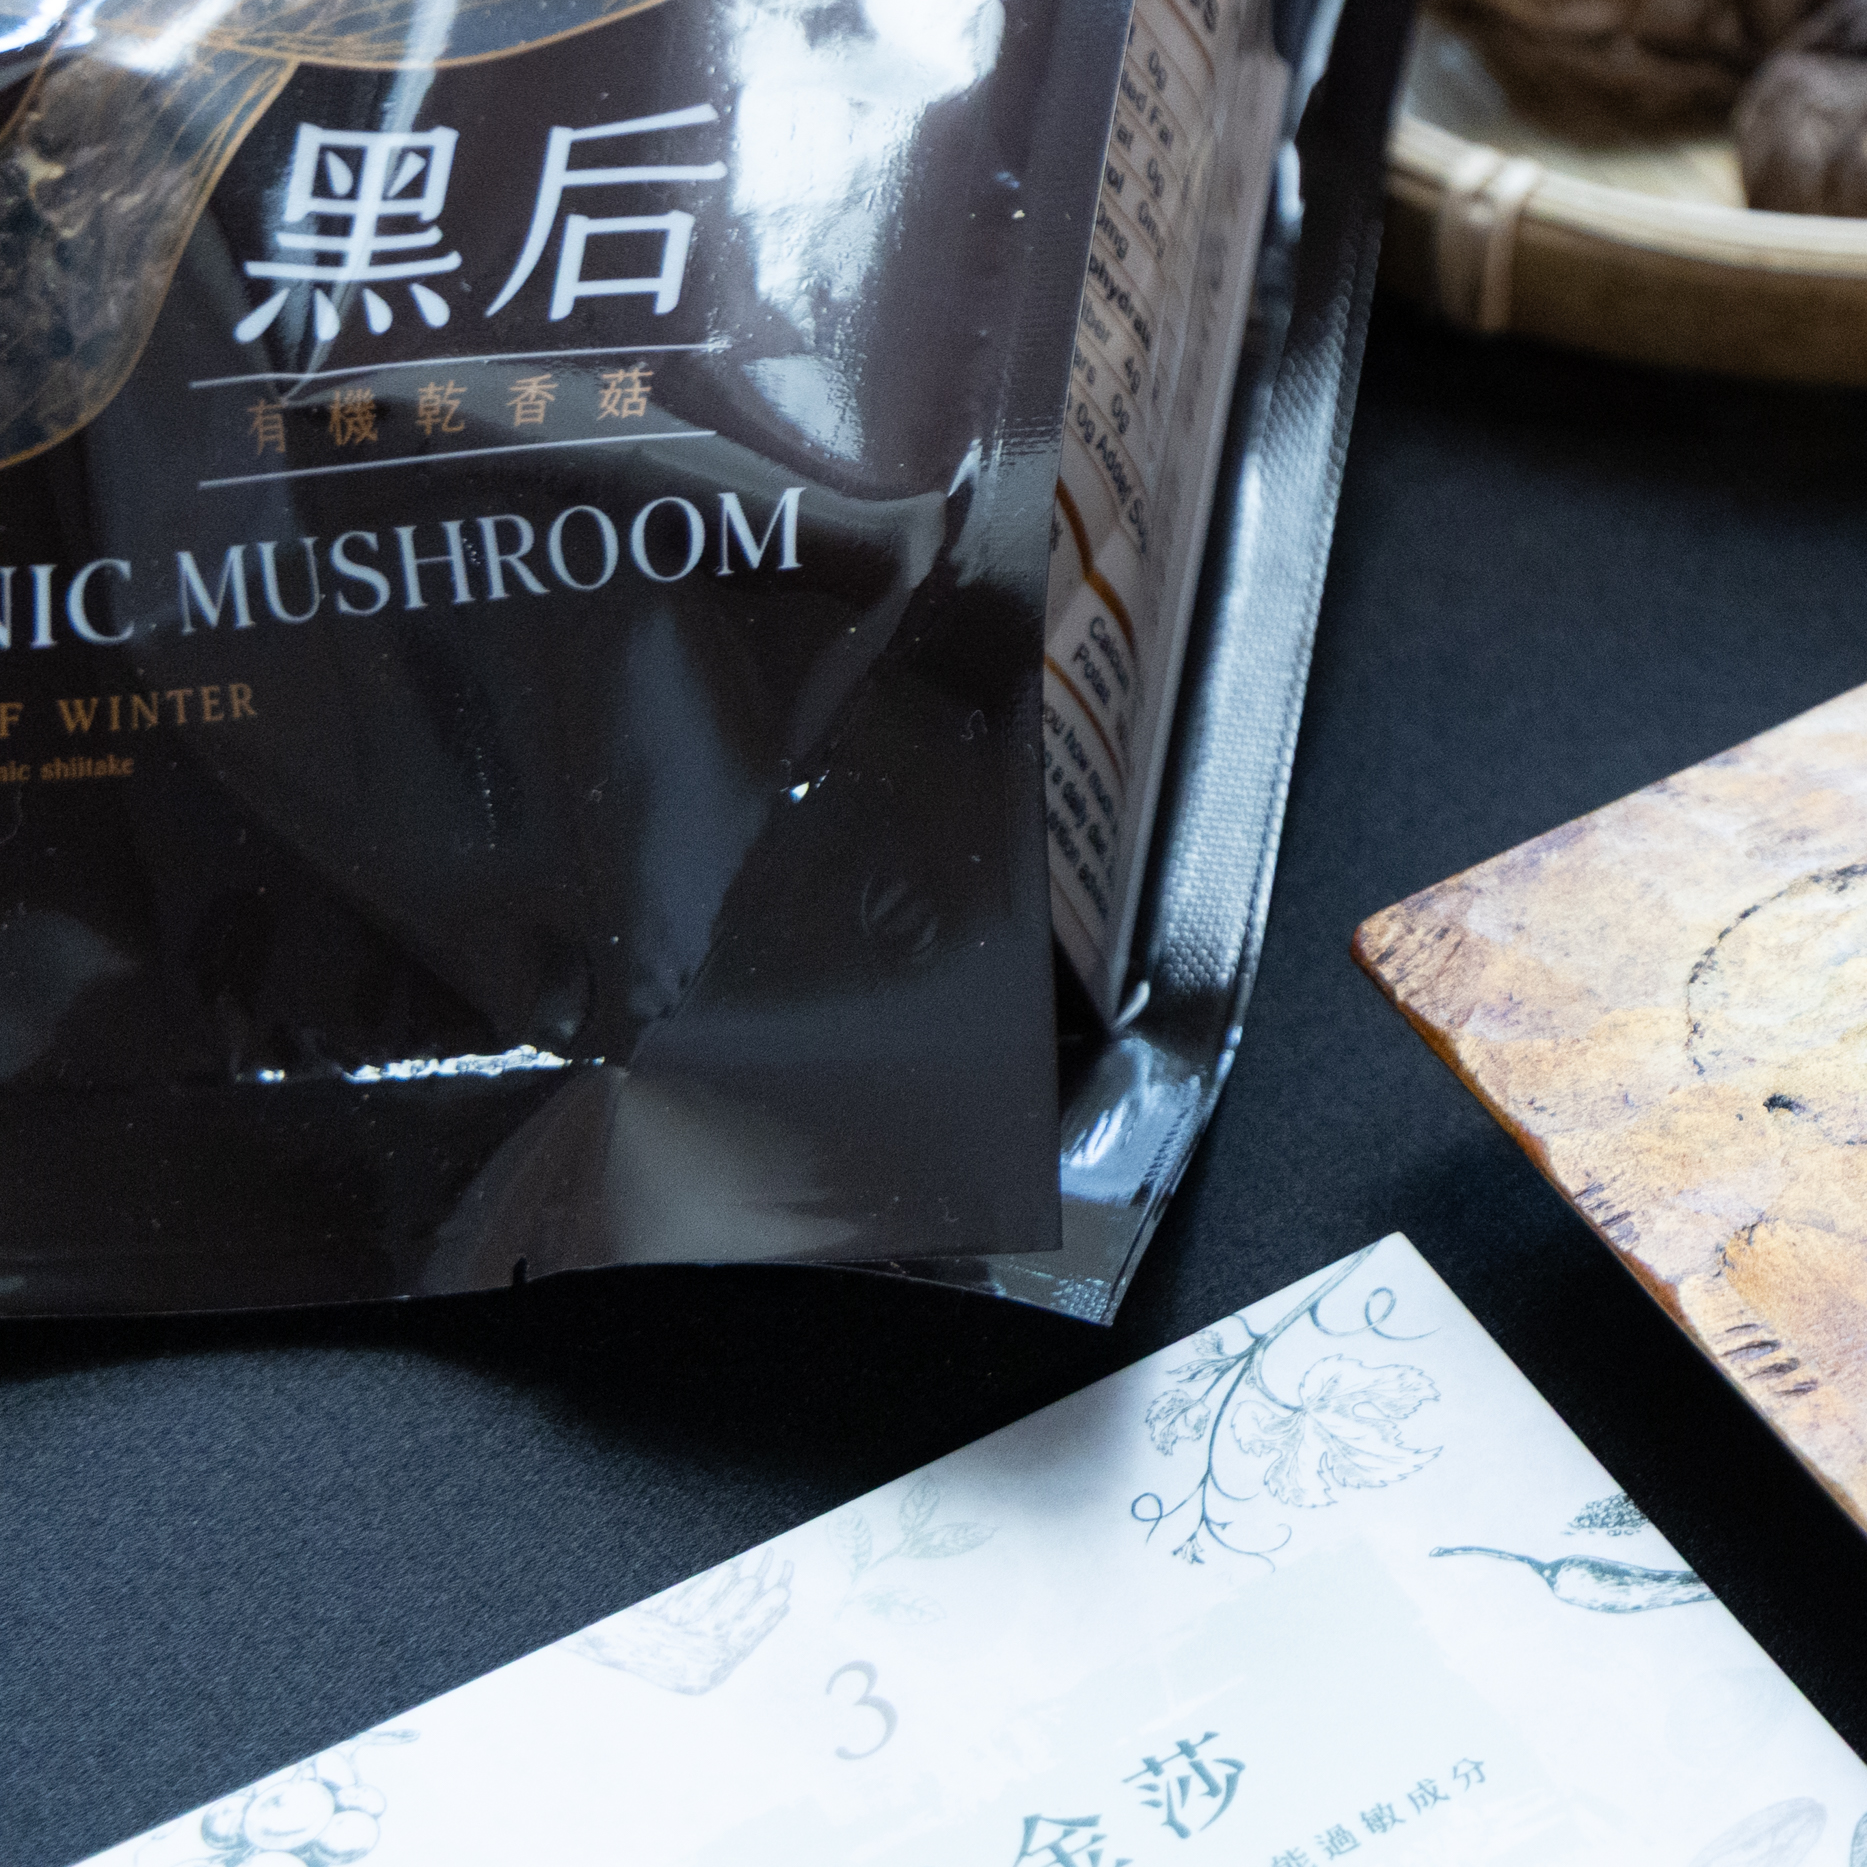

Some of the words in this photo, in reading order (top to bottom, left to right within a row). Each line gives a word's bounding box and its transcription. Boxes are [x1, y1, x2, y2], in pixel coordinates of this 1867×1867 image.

[234, 103, 728, 344] 黑后
[247, 369, 654, 456] 有機乾香菇
[175, 487, 807, 635] MUSHROOM
[56, 683, 258, 733] WINTER
[825, 1660, 899, 1760] 3
